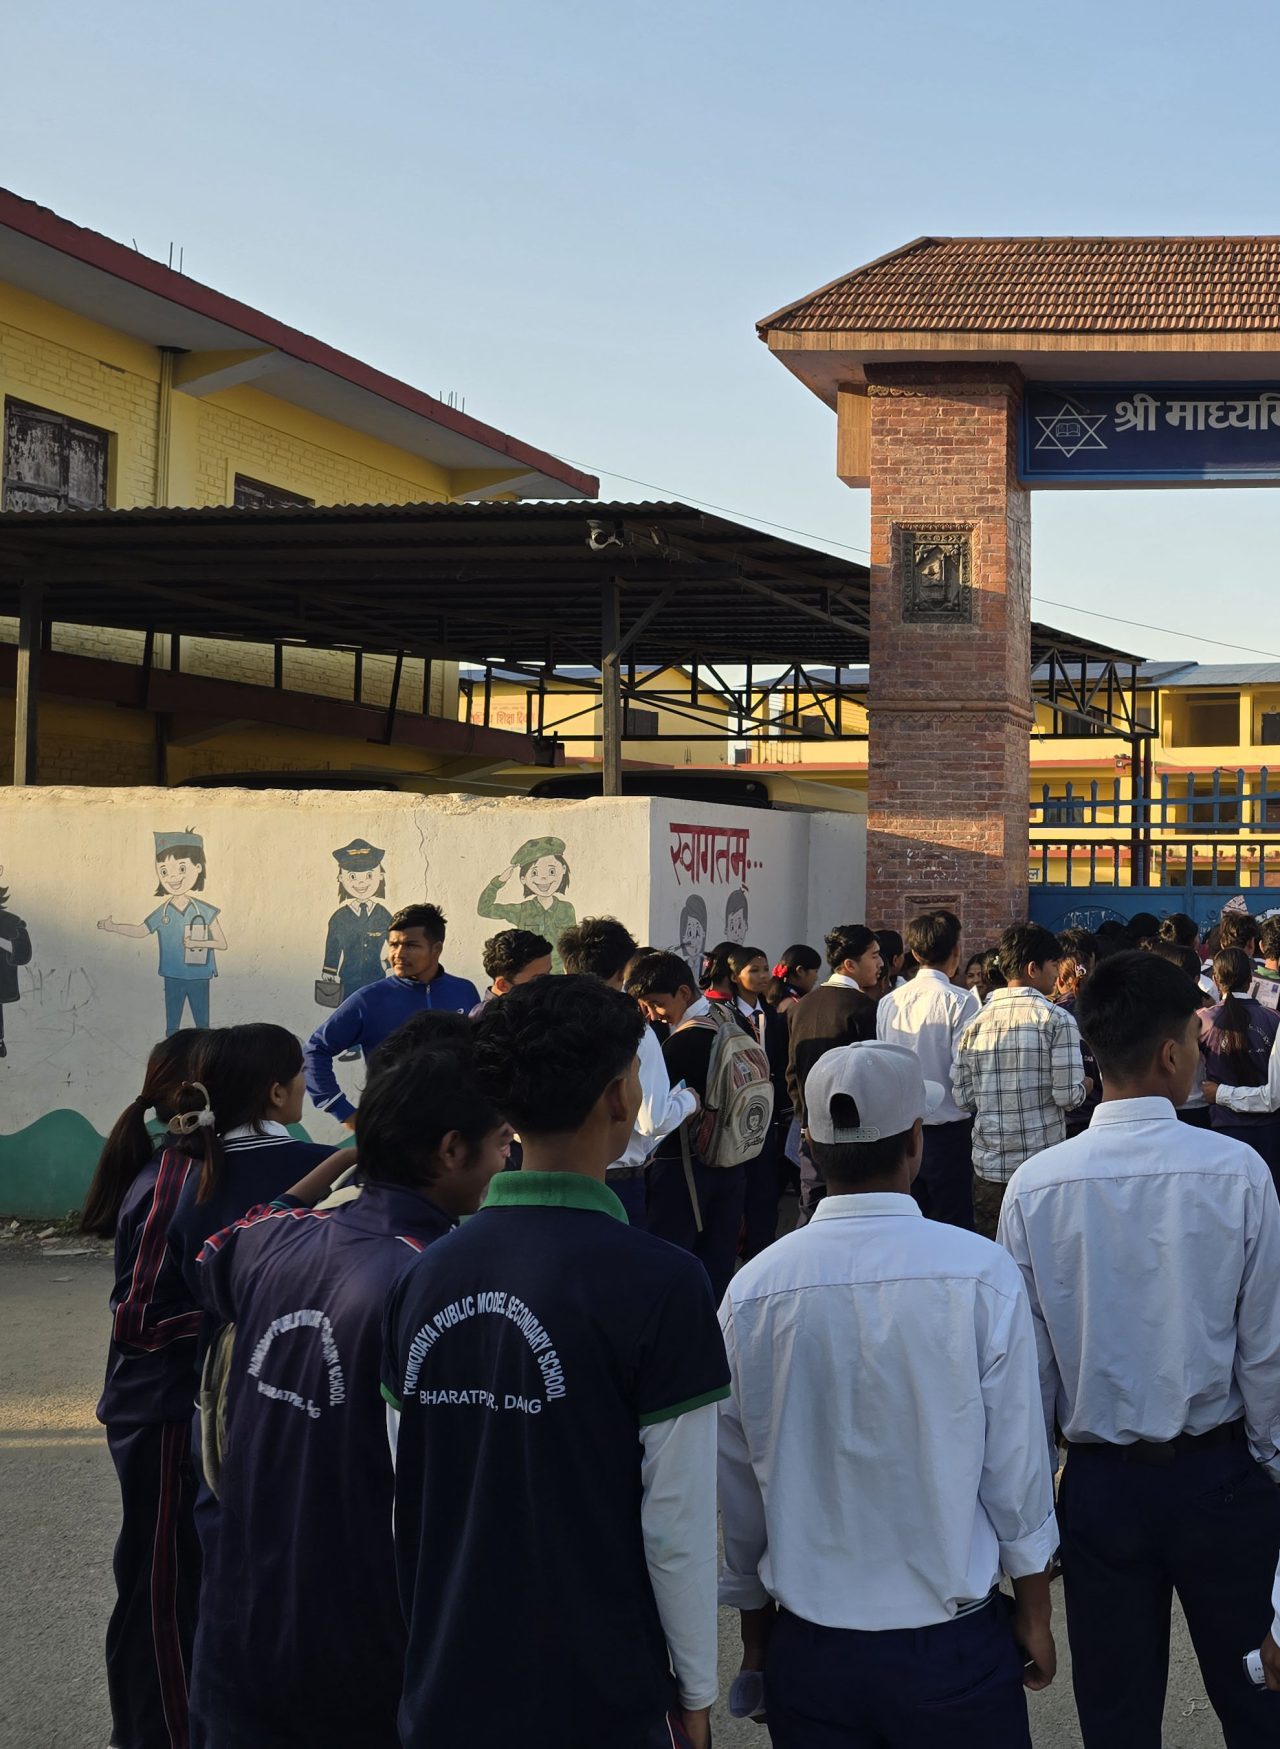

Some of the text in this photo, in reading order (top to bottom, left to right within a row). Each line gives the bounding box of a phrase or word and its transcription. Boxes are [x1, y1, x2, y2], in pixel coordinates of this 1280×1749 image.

[1114, 393, 1161, 432] श्री
[432, 1296, 475, 1334] PUBLIC
[477, 1291, 508, 1314] MODEL
[505, 1295, 553, 1353] SECONDARY
[537, 1350, 567, 1402] SCHOOL
[328, 1365, 346, 1406] SCHOOL
